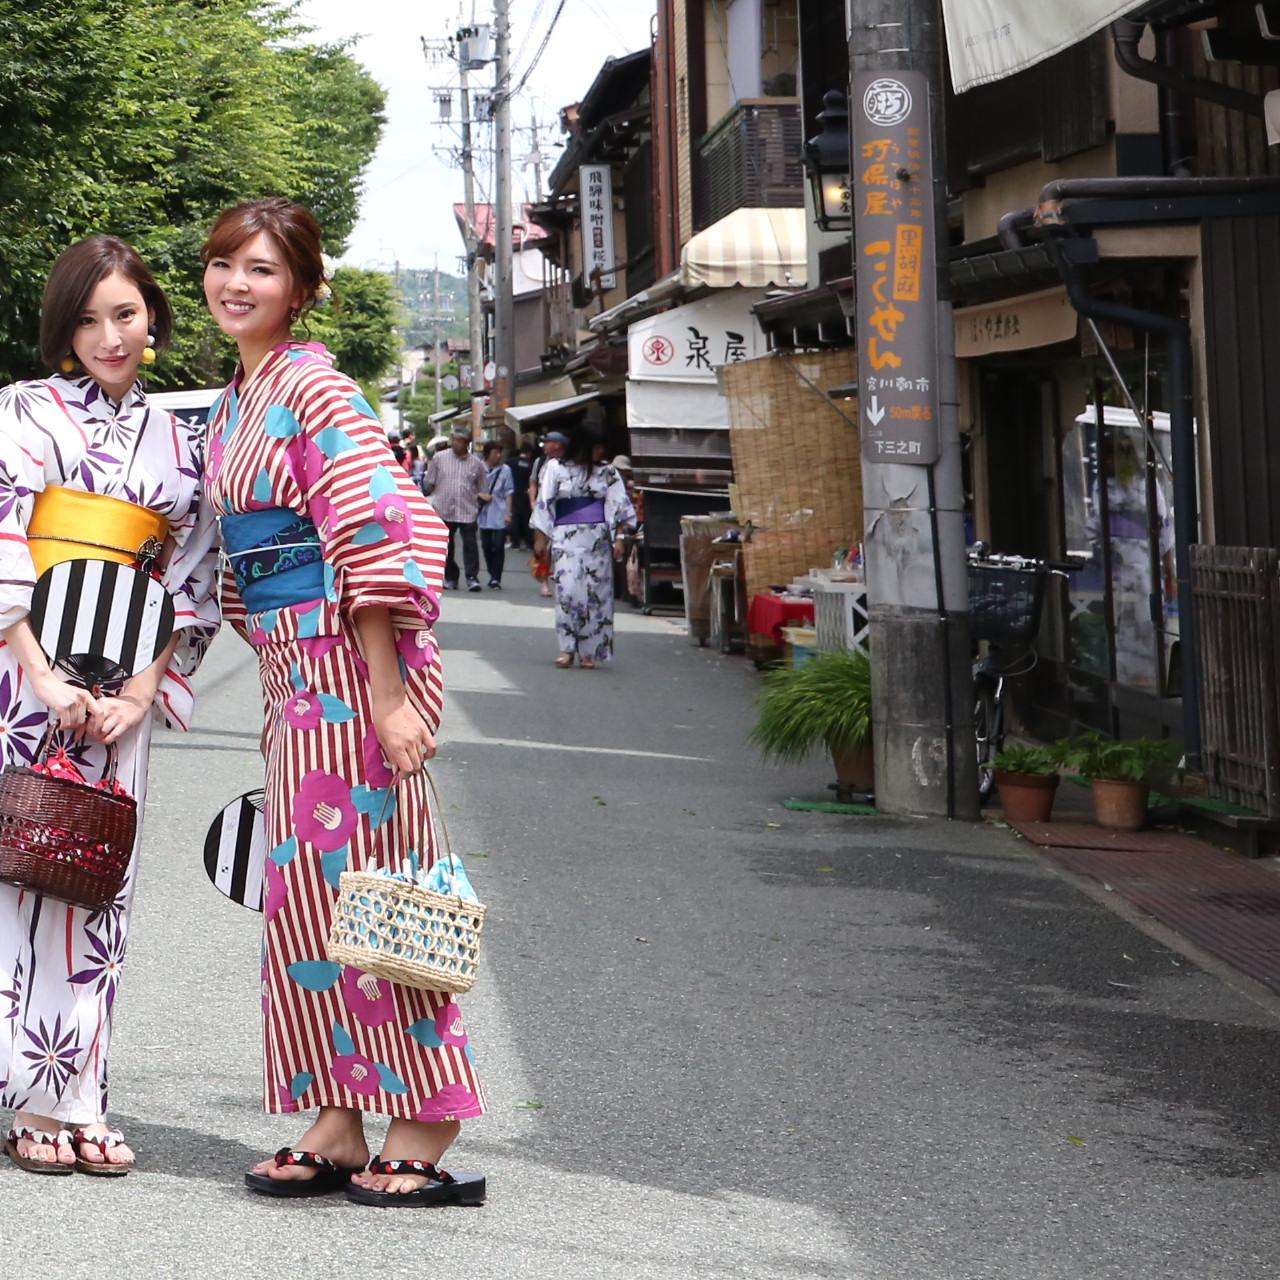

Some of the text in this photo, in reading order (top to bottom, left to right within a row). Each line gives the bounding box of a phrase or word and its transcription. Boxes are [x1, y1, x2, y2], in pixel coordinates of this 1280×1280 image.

[864, 240, 906, 370] こくせん
[685, 326, 746, 372] 泉屋
[866, 376, 930, 392] 宮川朝市
[874, 440, 922, 455] 下三之町
